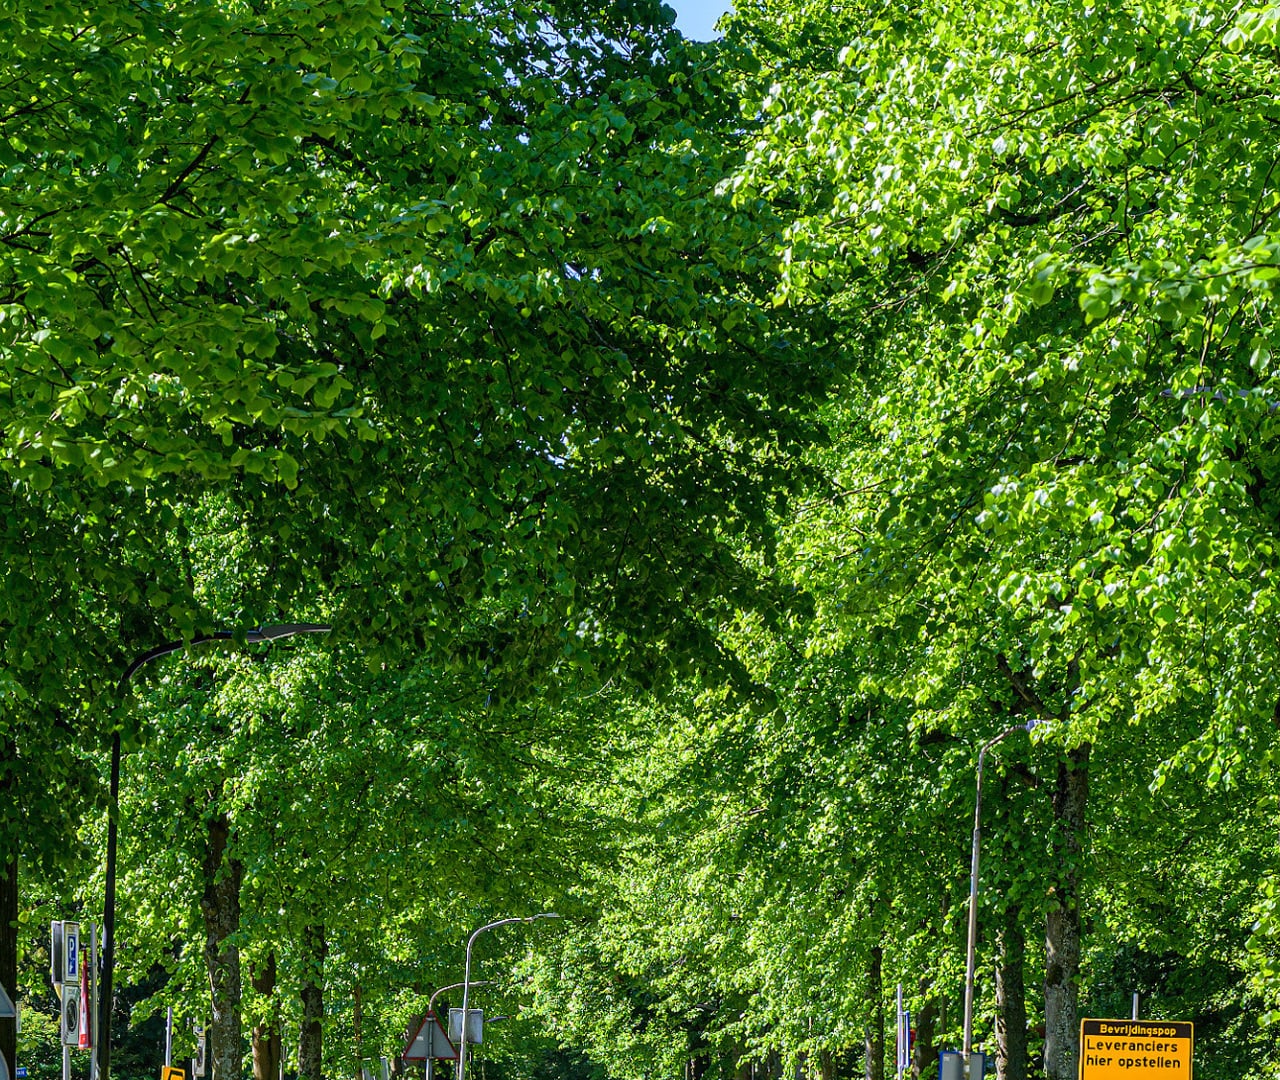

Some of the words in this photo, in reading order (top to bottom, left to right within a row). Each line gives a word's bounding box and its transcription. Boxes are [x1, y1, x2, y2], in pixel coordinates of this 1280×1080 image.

[1100, 1024, 1177, 1037] Bevrijdingspop
[1087, 1039, 1178, 1053] Leveranciers
[1086, 1055, 1113, 1066] hier
[1118, 1057, 1181, 1069] opstellen
